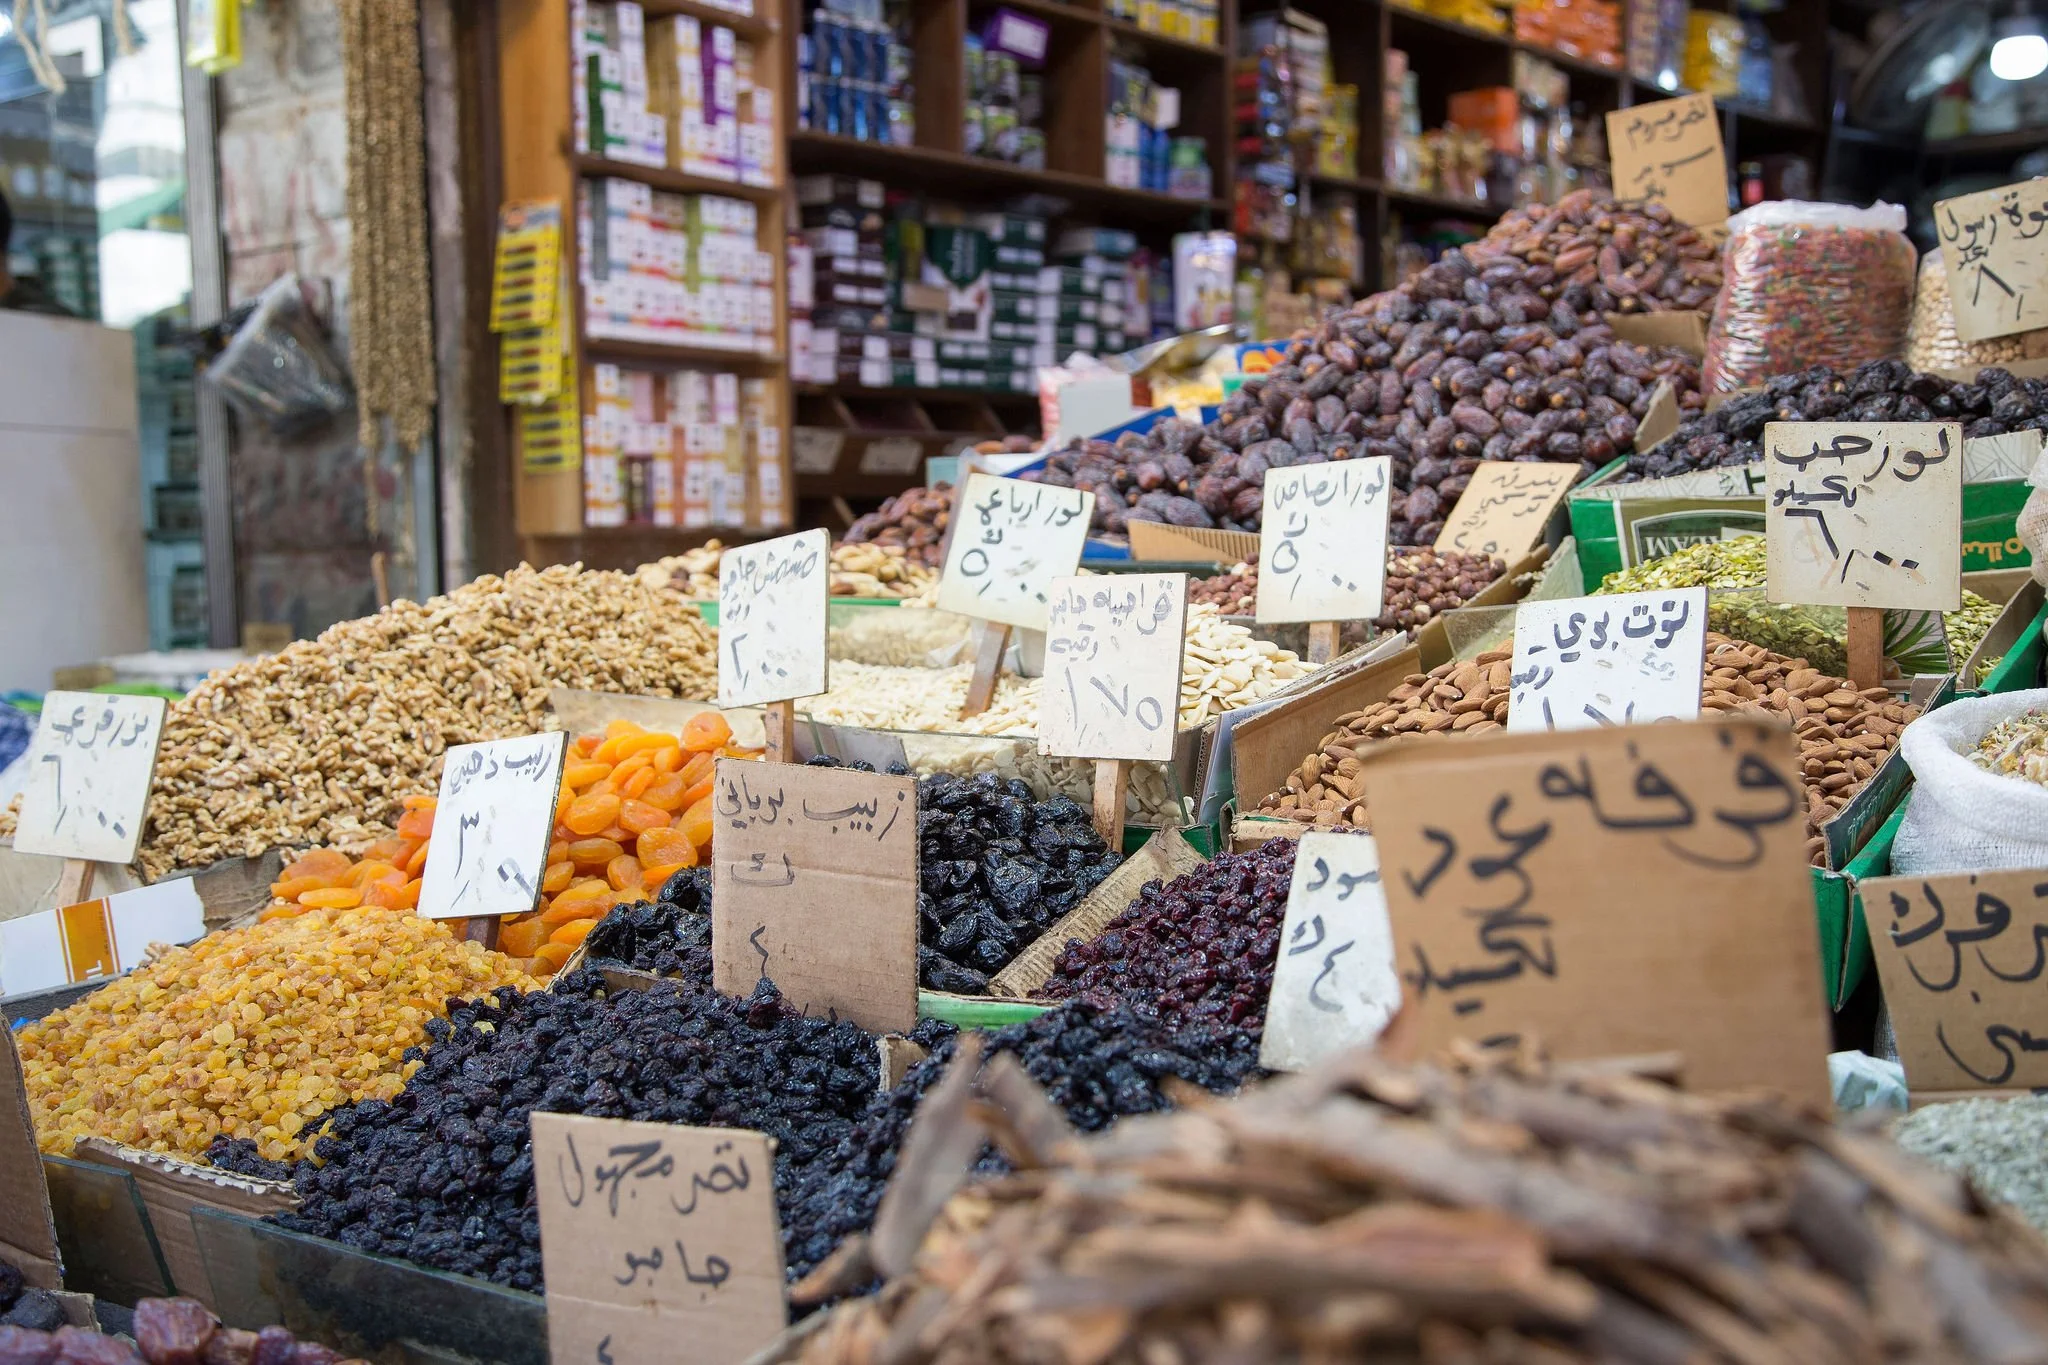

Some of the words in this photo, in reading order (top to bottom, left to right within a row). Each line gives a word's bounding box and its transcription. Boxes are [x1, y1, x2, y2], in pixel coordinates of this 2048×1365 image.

[1774, 435, 1873, 473] حب
[1863, 427, 1950, 483] لوز
[1044, 491, 1083, 526] لوز
[1351, 464, 1384, 507] لوز
[1553, 610, 1619, 663] بري
[1622, 600, 1689, 649] توت
[504, 743, 556, 782] زبيب
[803, 790, 905, 842] زبيب
[558, 1133, 673, 1217] مجهول
